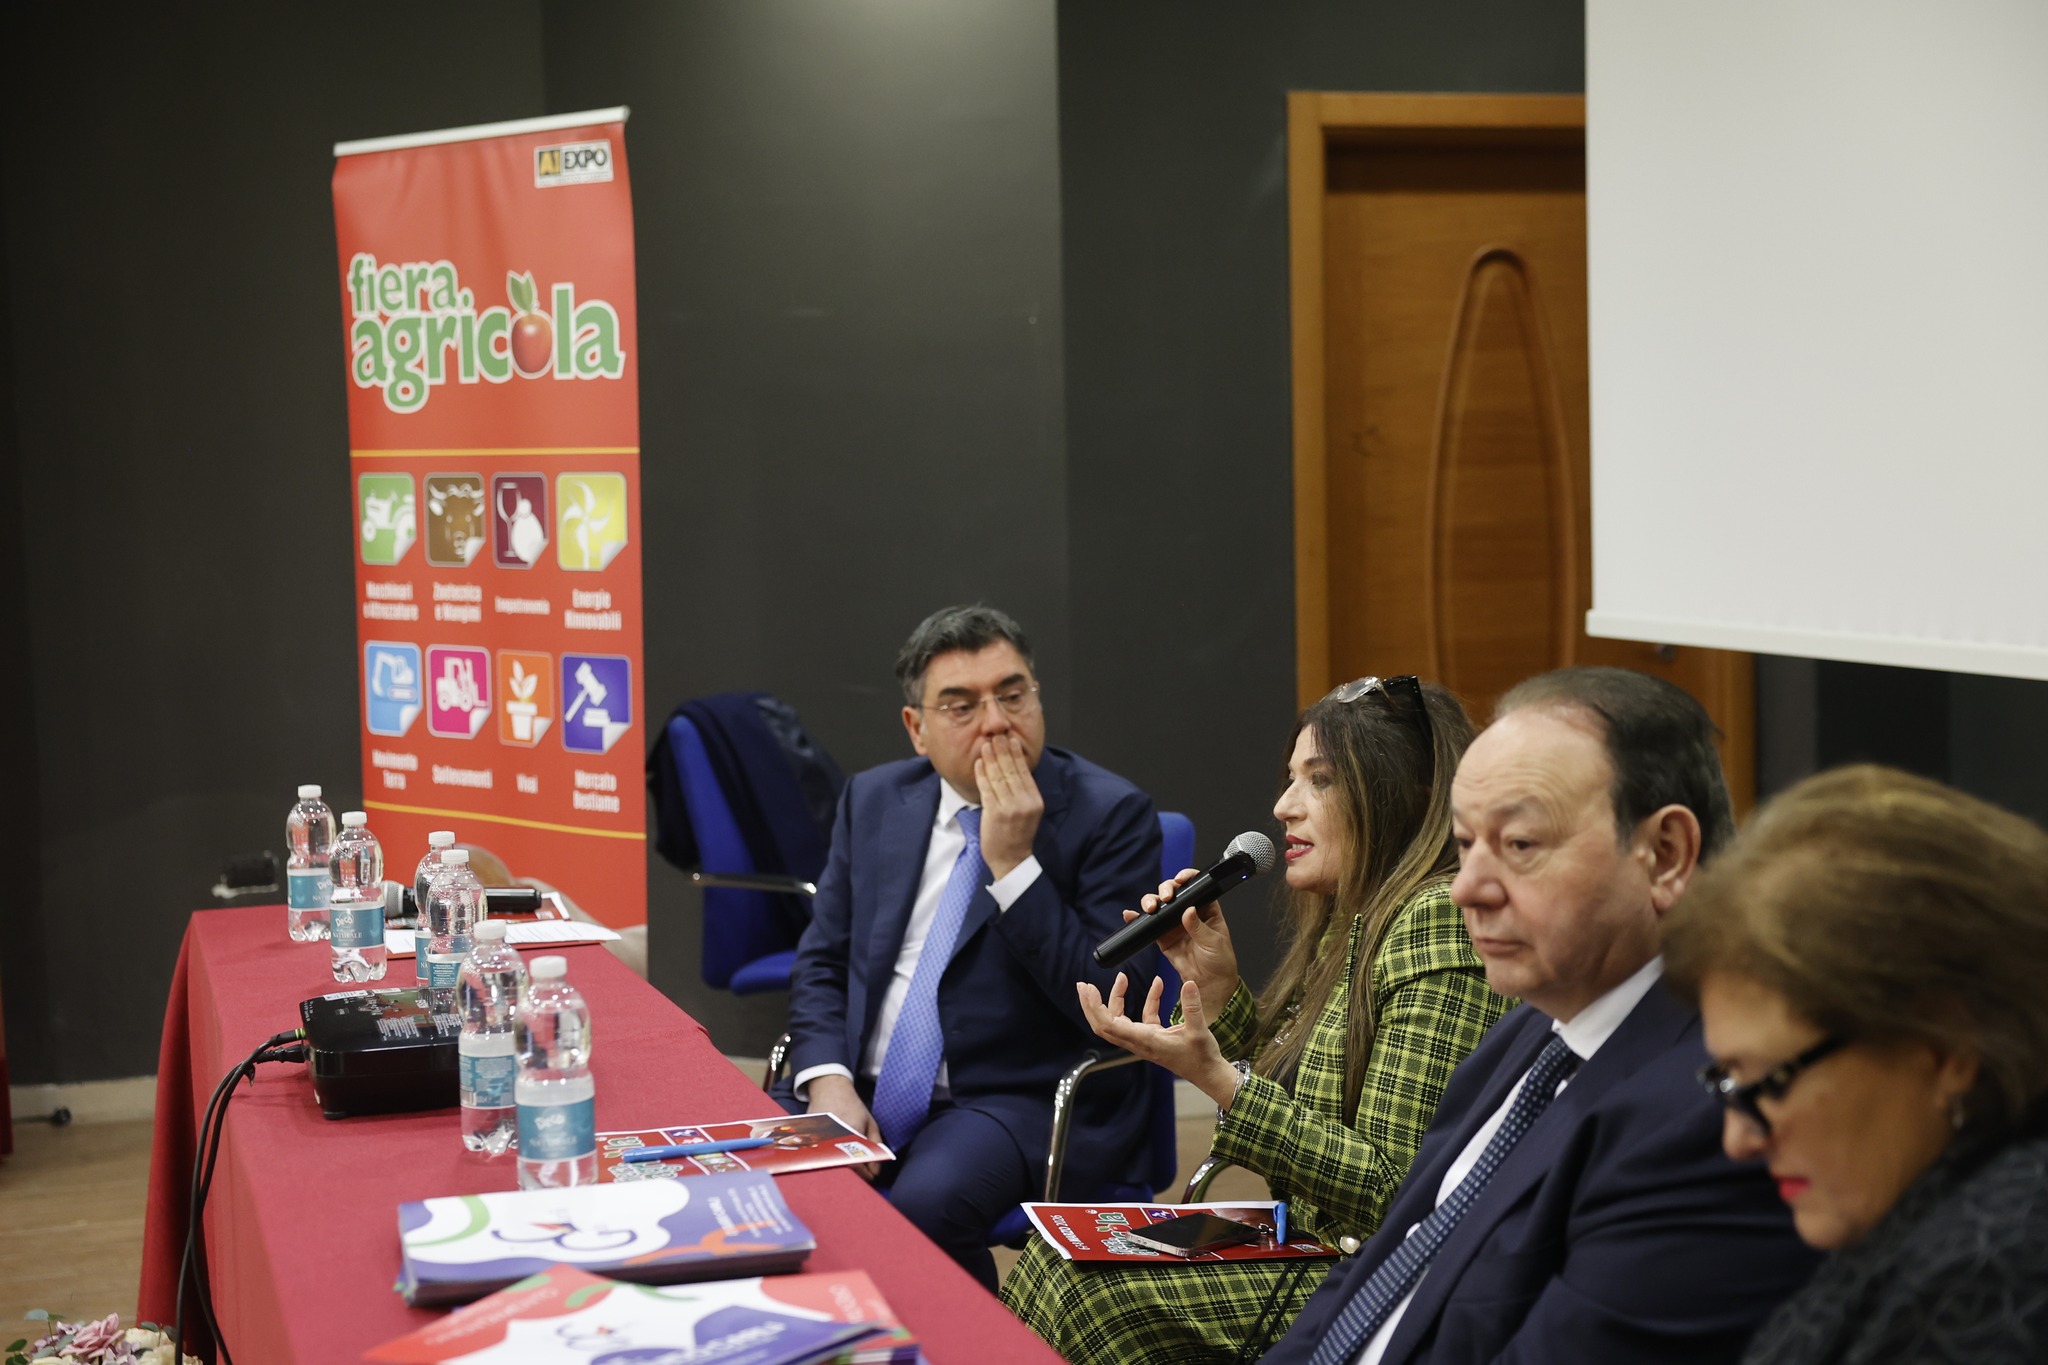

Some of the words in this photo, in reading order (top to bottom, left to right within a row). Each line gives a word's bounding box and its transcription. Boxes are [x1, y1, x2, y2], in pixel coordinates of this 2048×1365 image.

[564, 148, 607, 170] EXPO
[572, 588, 612, 610] Energie
[575, 769, 617, 792] Mercato
